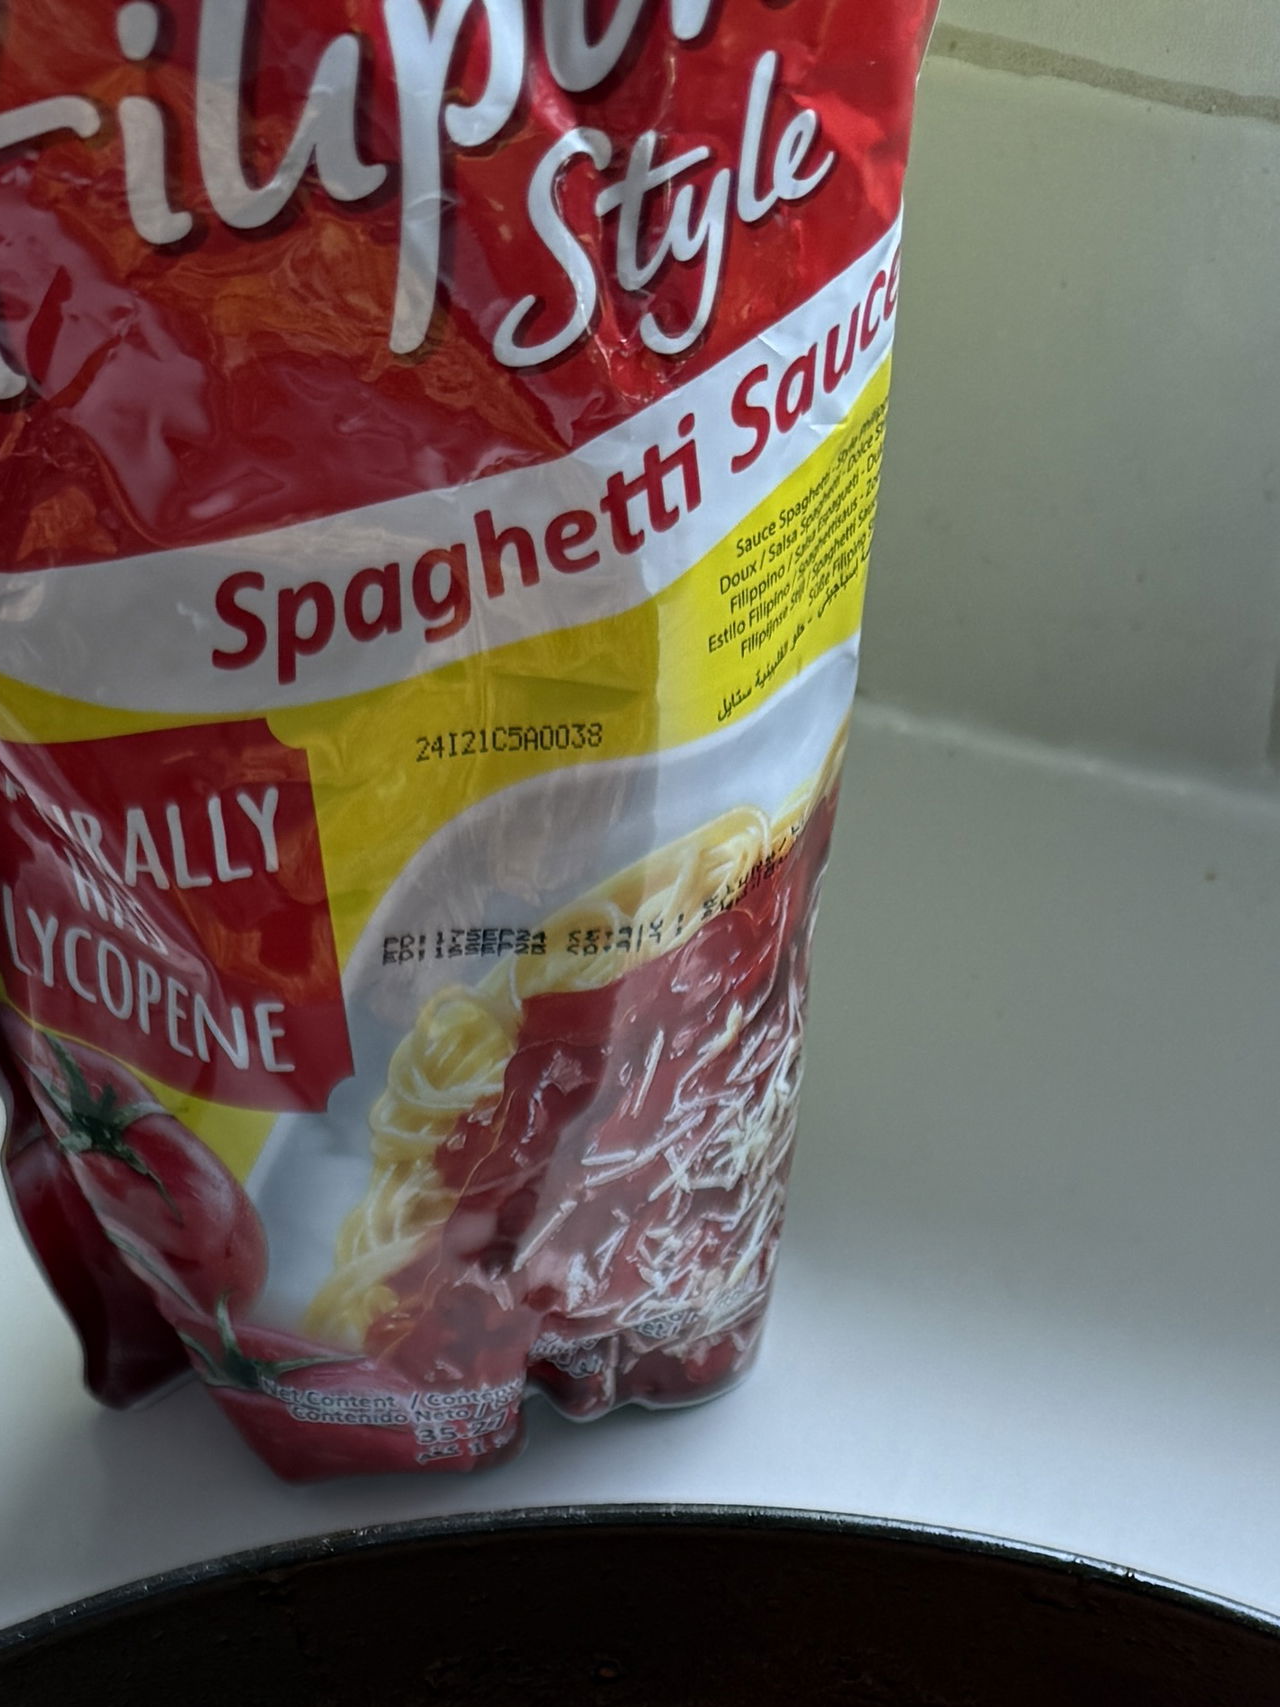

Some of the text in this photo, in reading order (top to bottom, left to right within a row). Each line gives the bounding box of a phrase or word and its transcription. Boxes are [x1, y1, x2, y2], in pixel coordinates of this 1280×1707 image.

[492, 50, 834, 368] Style
[211, 412, 701, 686] Spaghetti
[720, 561, 757, 595] Doux
[768, 527, 798, 563] Salsa
[736, 521, 776, 558] Sauce
[708, 620, 746, 654] Estilo
[748, 582, 790, 628] Filipino
[730, 564, 785, 615] Filippino
[2, 883, 296, 1073] LYCOPENE
[291, 1405, 408, 1424] Contenido
[415, 1408, 469, 1423] Neto
[306, 1390, 397, 1409] Content
